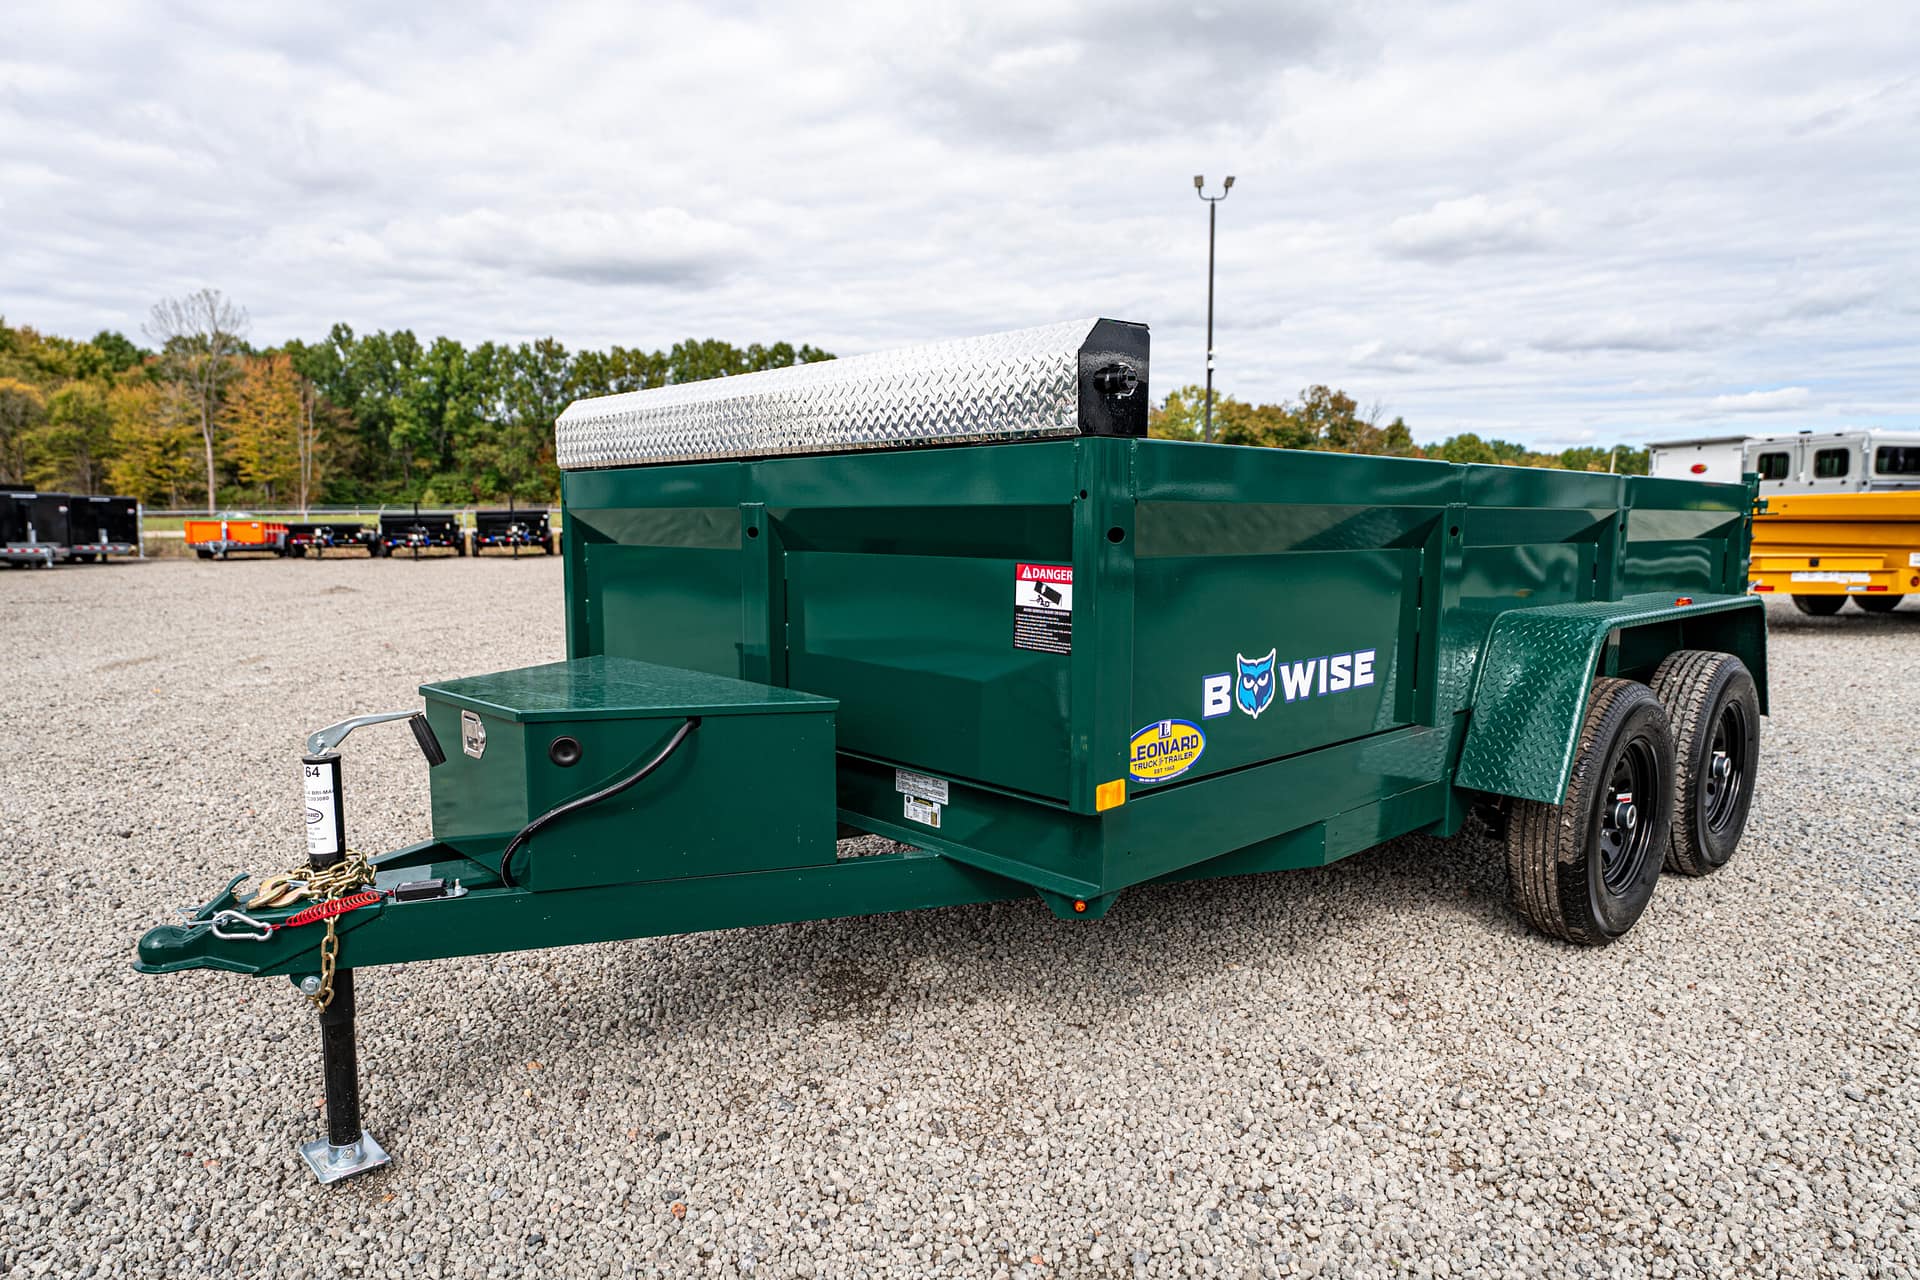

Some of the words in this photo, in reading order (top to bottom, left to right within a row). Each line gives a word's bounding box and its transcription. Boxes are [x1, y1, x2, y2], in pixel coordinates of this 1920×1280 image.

[1032, 567, 1073, 581] DANGER
[1131, 734, 1199, 762] EONARD
[1133, 759, 1157, 771] TRUCK
[1165, 752, 1193, 765] TRAILER
[305, 766, 320, 778] 64
